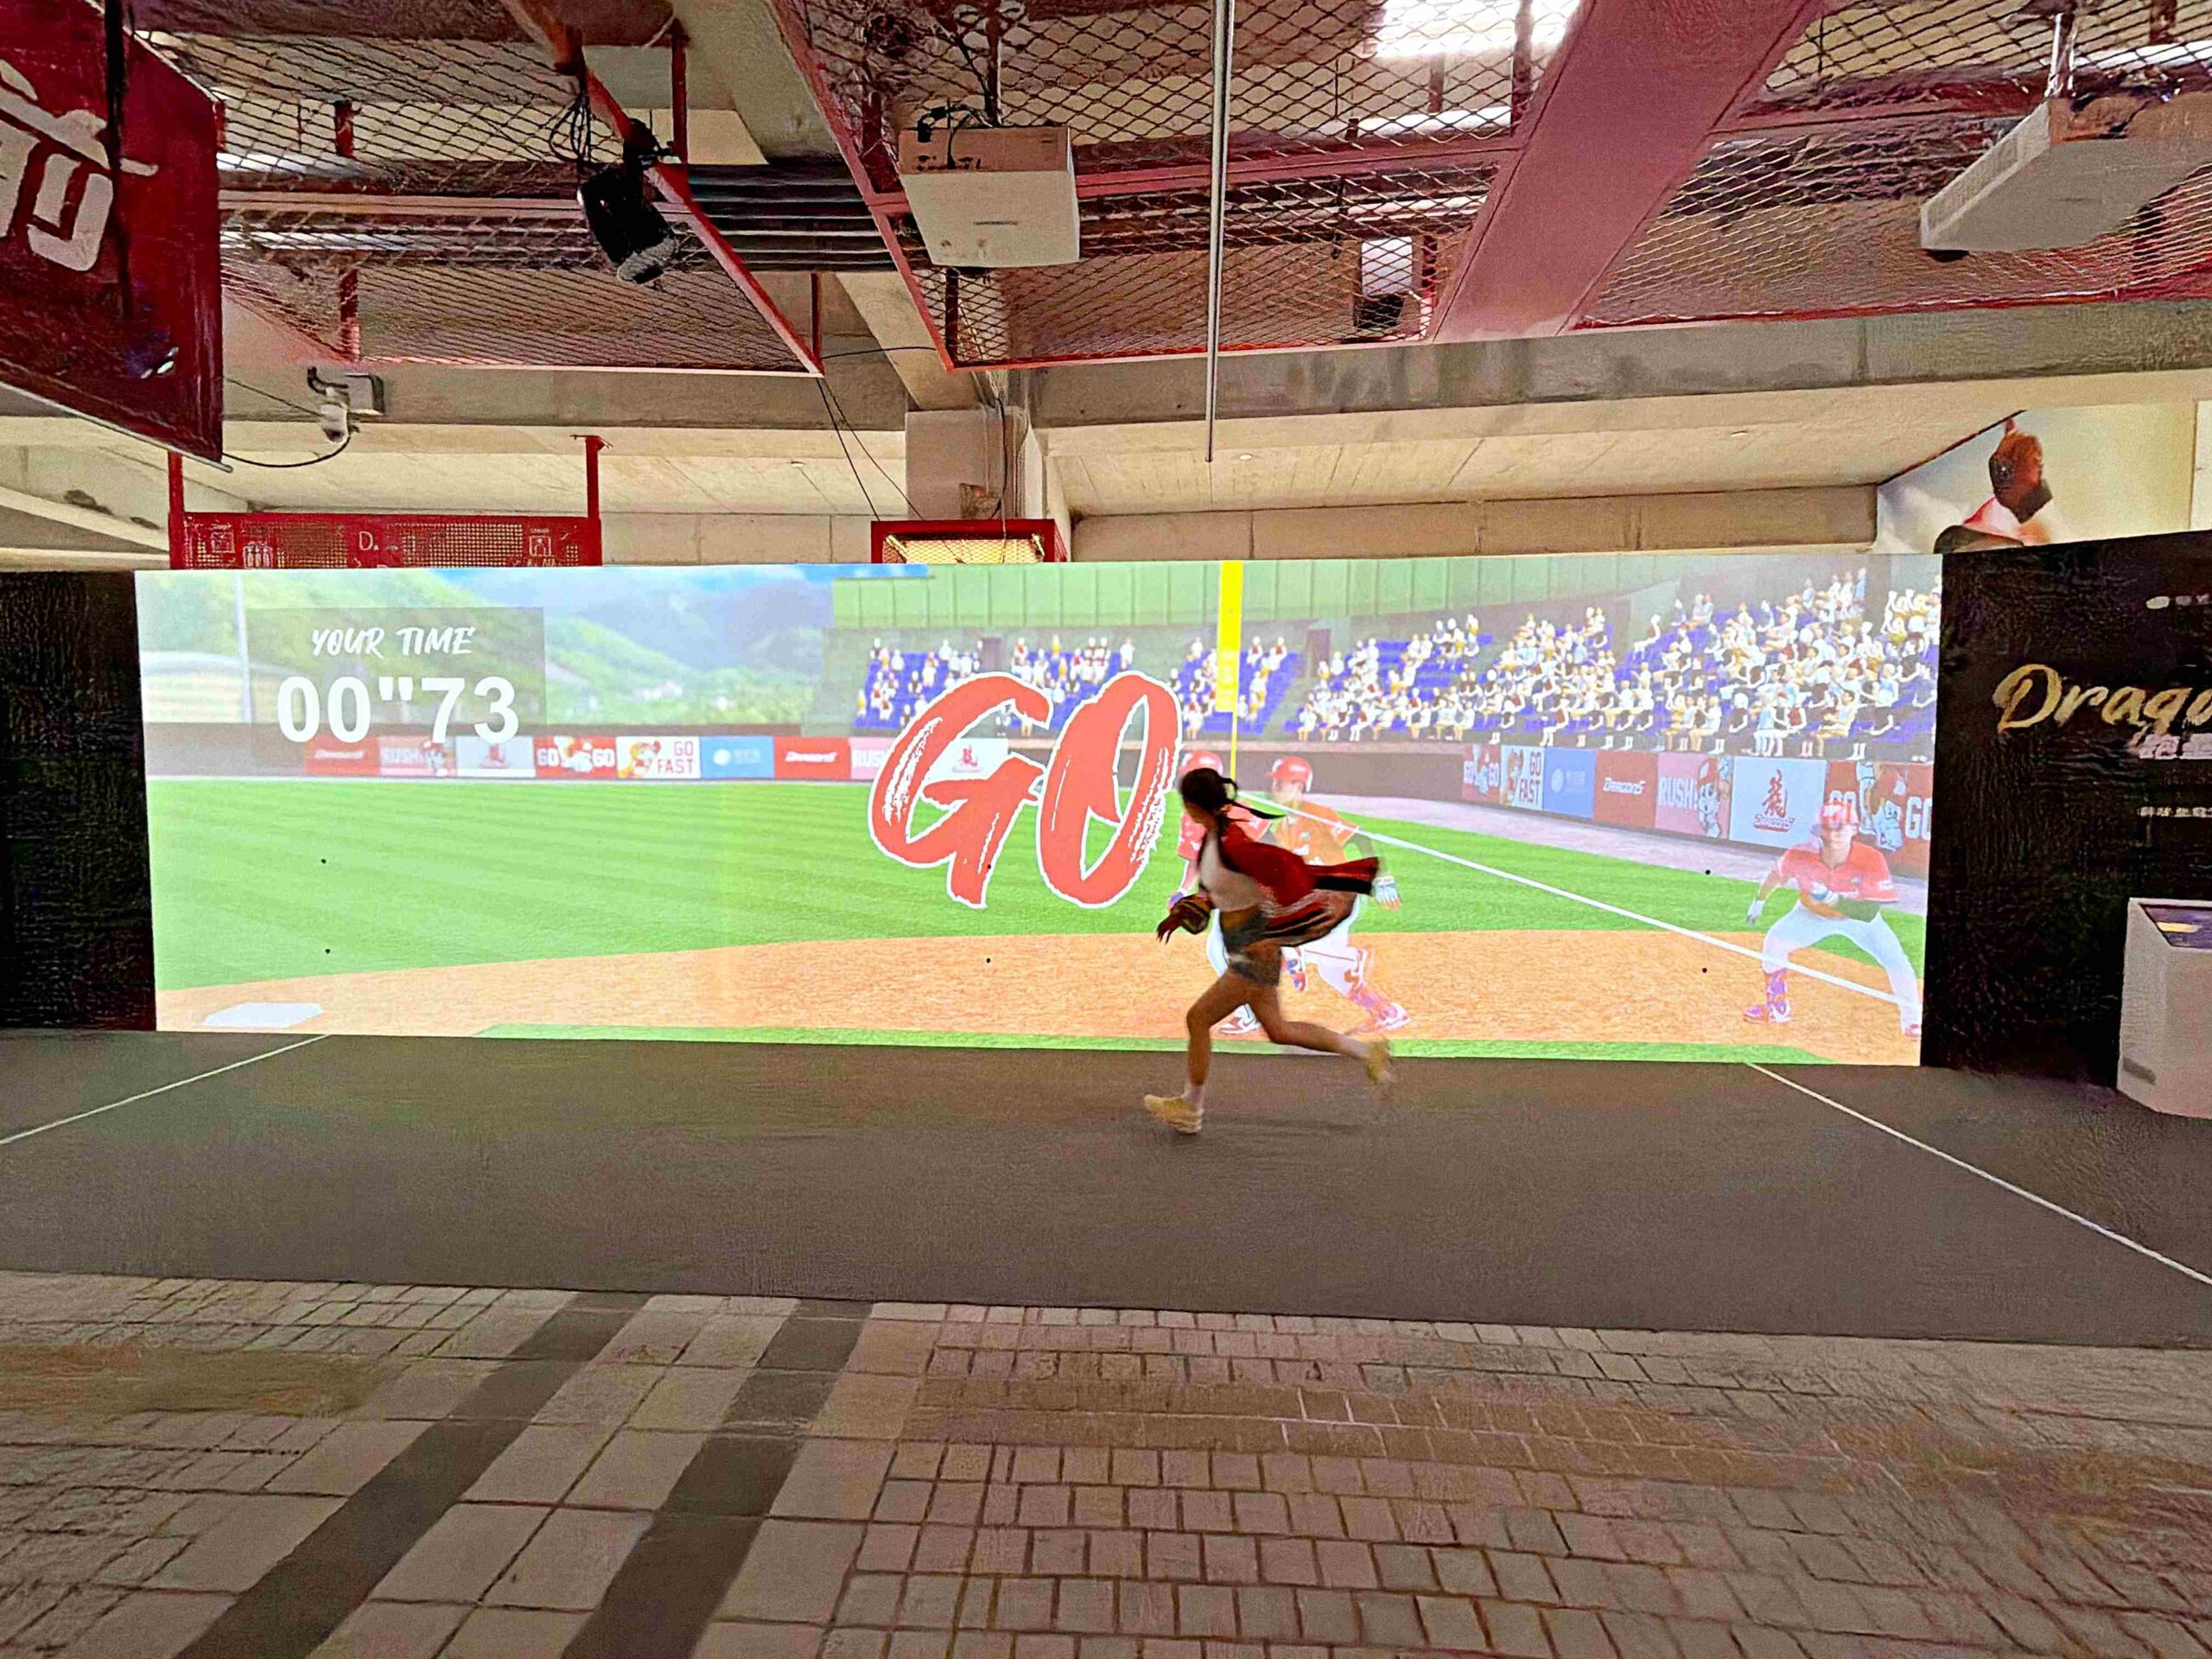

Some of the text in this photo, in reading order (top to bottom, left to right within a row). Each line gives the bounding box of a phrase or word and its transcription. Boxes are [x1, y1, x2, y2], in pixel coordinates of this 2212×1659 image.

[311, 626, 476, 660] YOUR TIME
[657, 758, 695, 774] FAST
[868, 670, 1185, 910] GO
